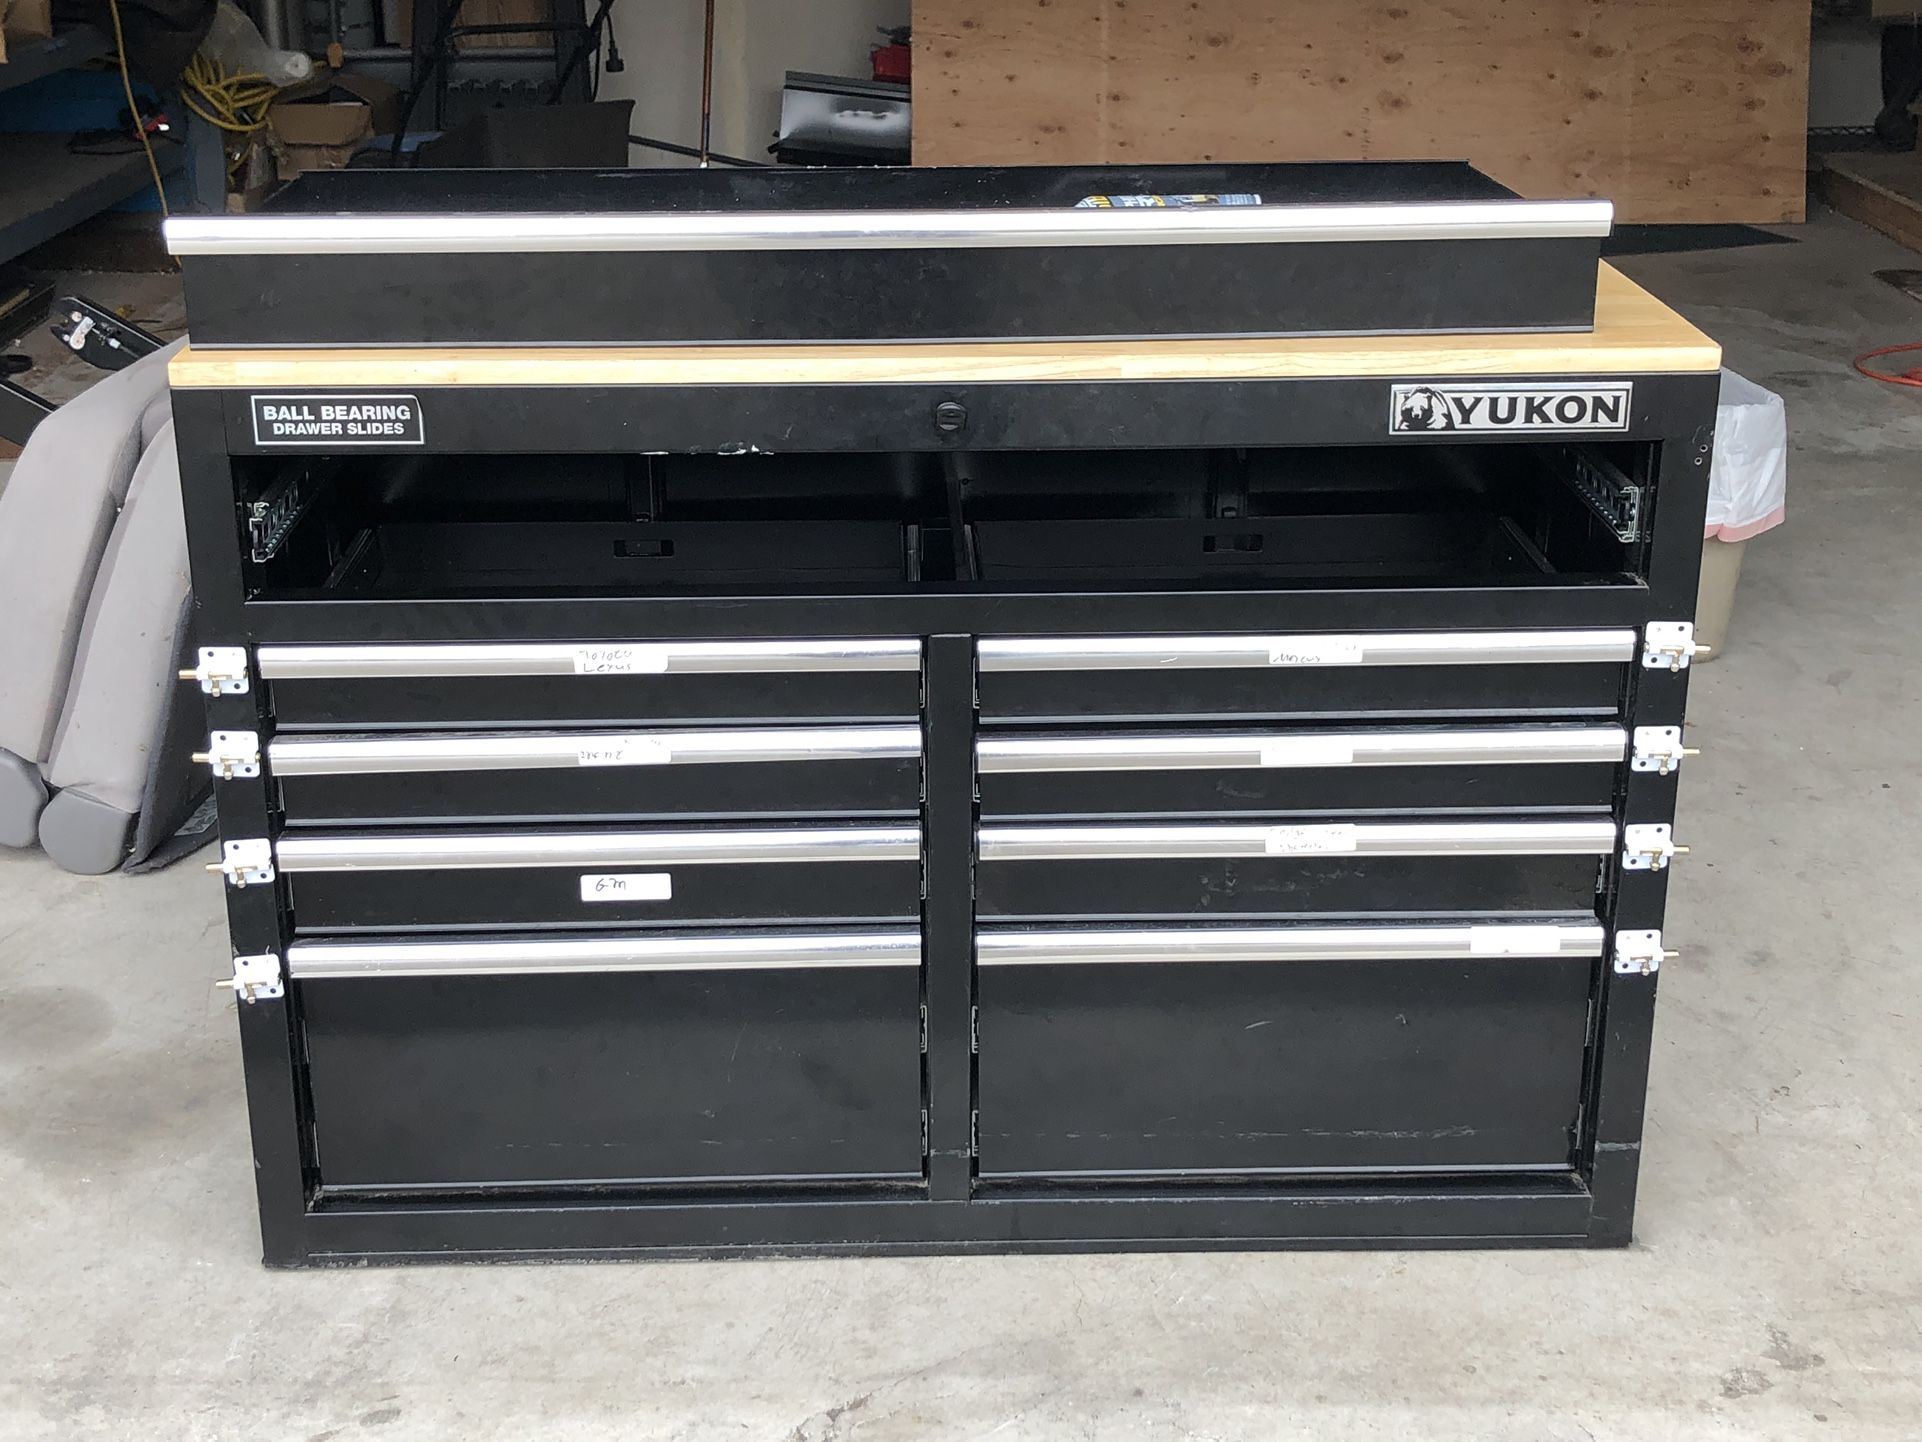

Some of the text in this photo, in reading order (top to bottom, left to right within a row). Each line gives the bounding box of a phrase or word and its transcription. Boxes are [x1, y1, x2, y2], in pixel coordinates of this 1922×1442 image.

[263, 405, 411, 420] BALL BEARING
[1451, 395, 1622, 425] YUKON
[273, 422, 405, 435] DRAWER SLIDES
